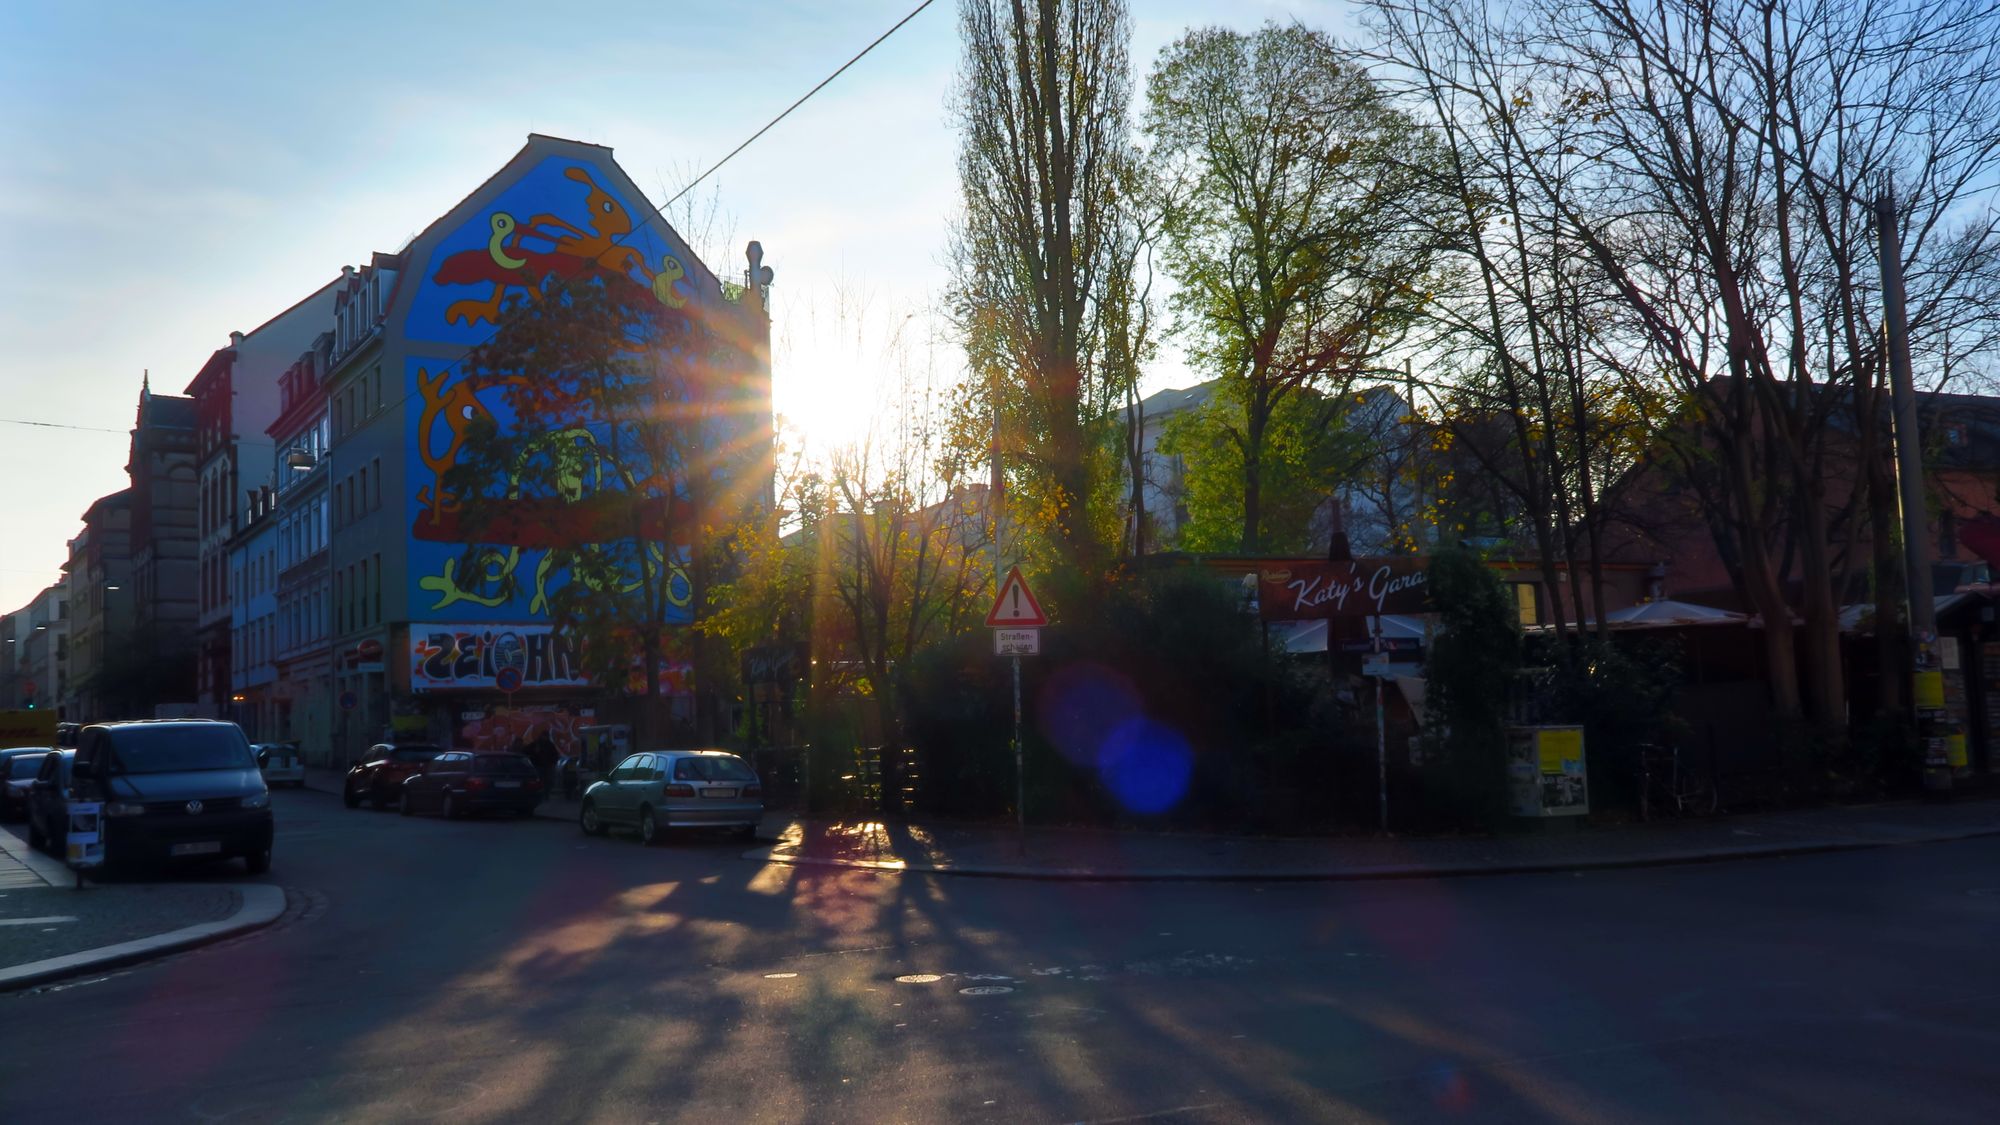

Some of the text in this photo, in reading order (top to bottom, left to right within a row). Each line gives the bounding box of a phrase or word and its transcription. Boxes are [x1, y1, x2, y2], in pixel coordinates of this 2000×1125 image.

[1287, 561, 1429, 613] Katy's Gara
[1000, 631, 1034, 641] Straßen-
[1002, 643, 1033, 653] schen
